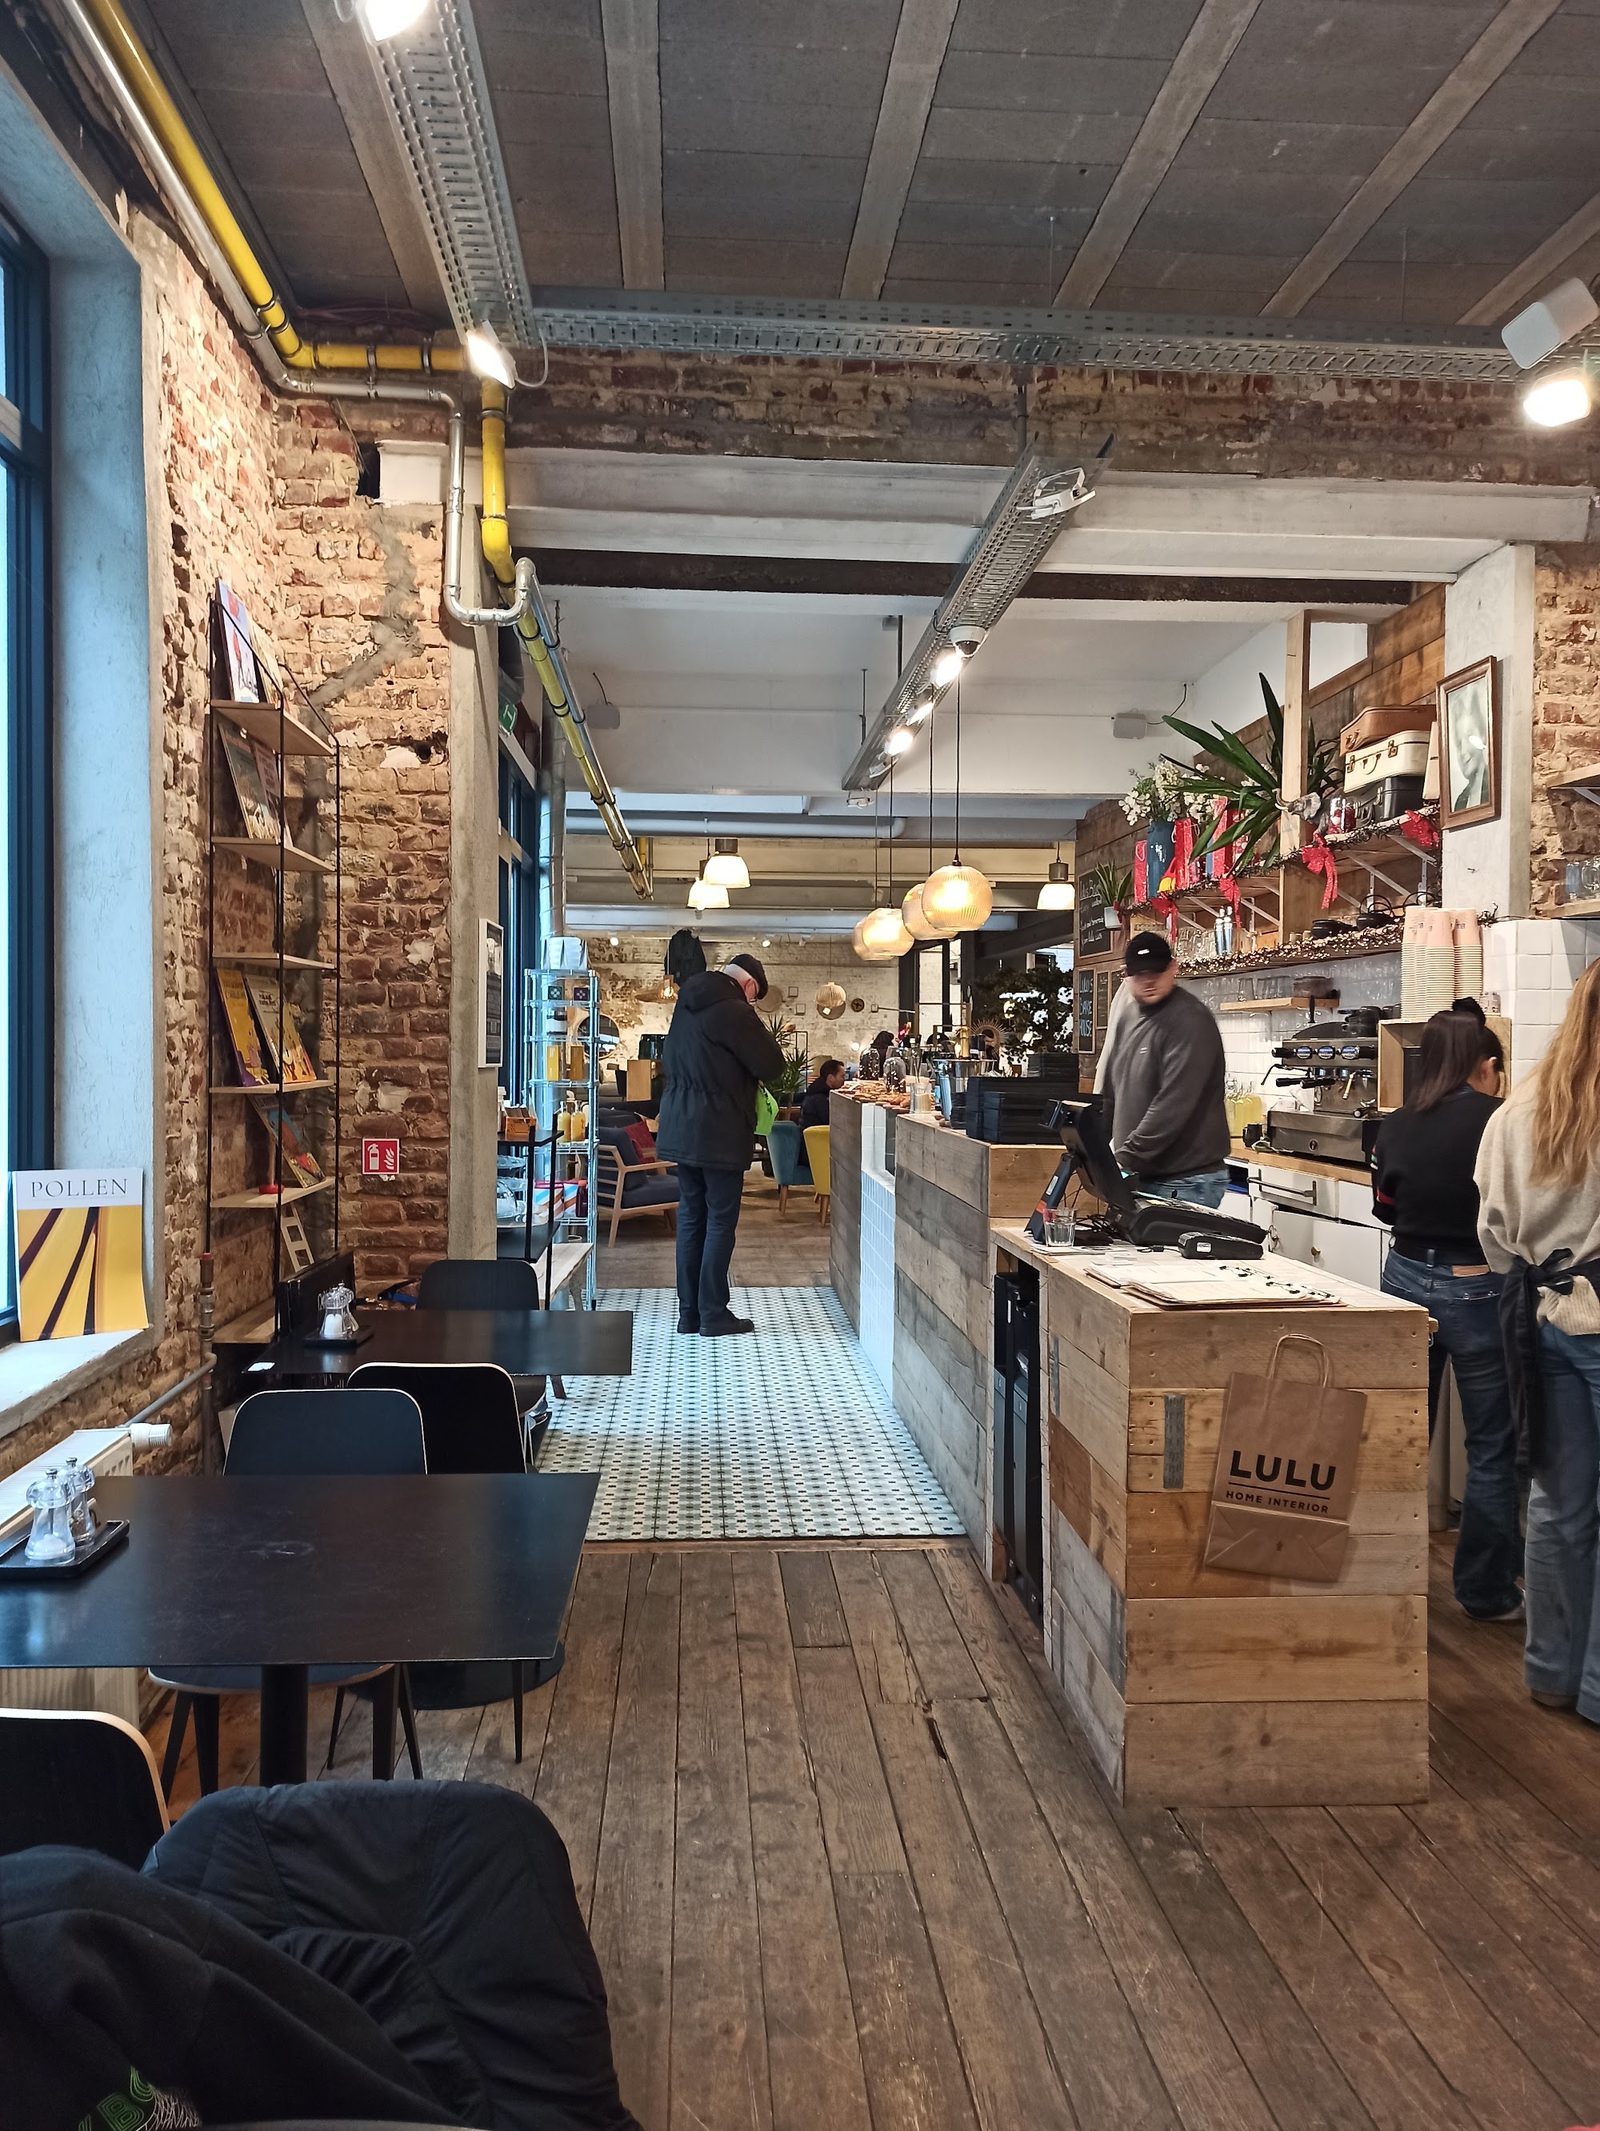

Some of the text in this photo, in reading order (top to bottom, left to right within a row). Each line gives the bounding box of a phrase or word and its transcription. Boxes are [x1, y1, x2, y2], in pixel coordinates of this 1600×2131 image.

[31, 1178, 127, 1198] POLLEN
[1230, 1450, 1336, 1491] LULU
[1226, 1490, 1329, 1514] HOME INTERIOR
